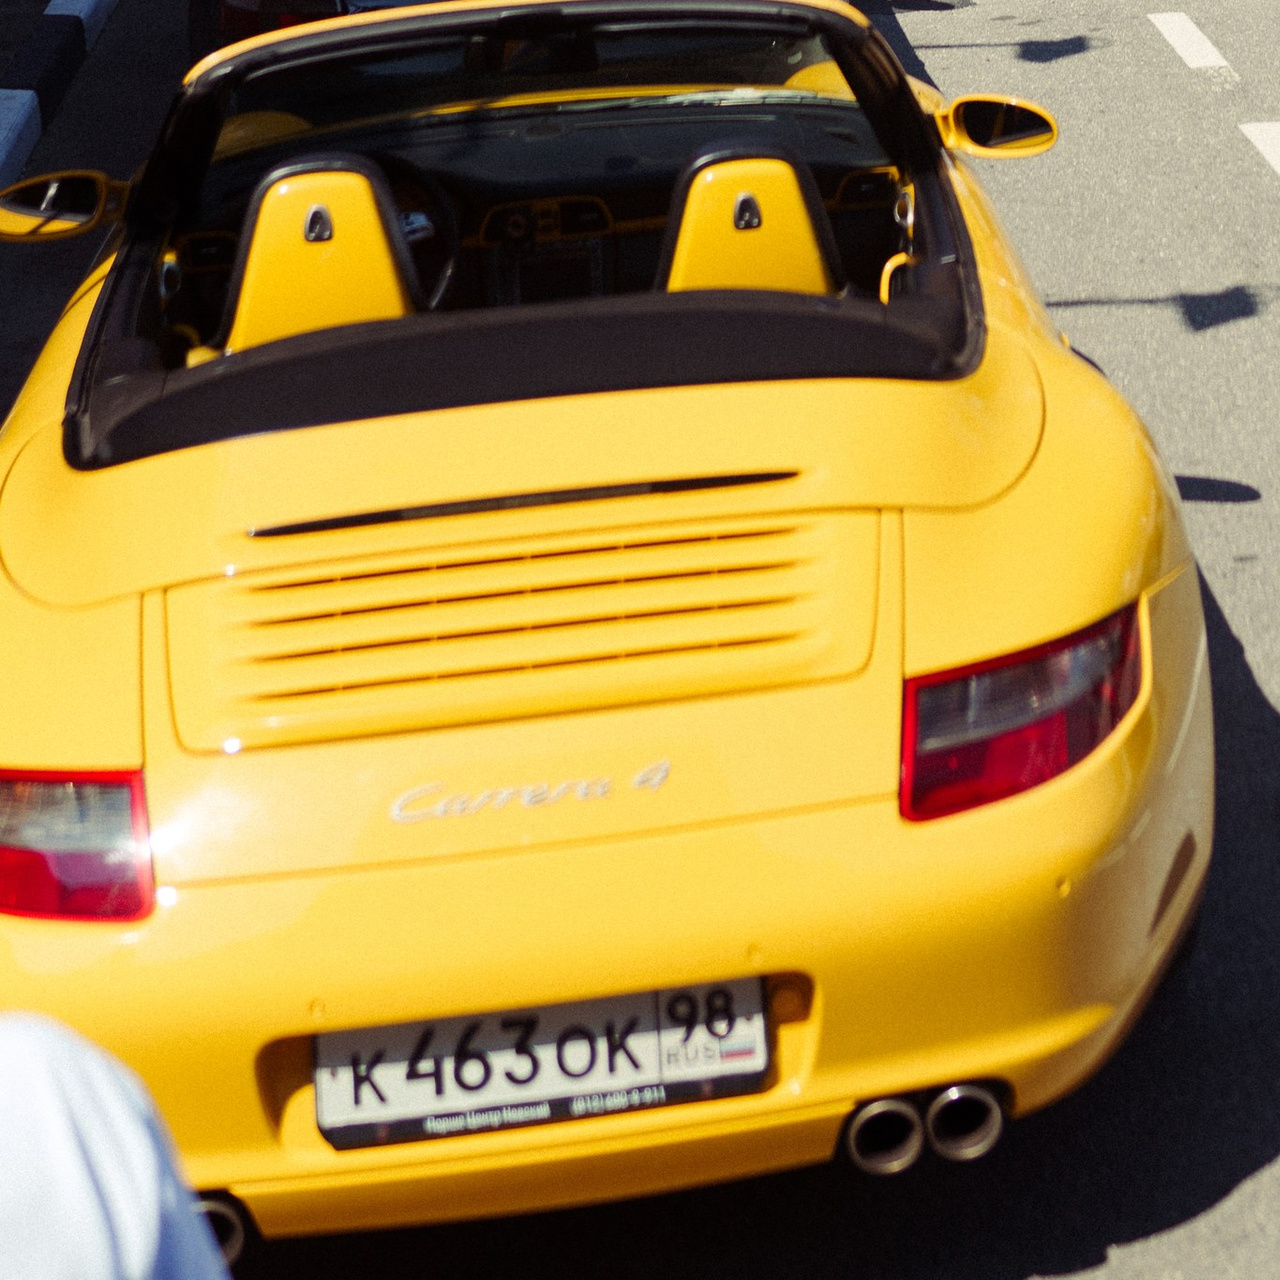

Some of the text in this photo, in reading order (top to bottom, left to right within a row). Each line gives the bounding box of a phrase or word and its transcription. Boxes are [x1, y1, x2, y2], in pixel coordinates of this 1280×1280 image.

[390, 758, 671, 825] Carrera 4
[665, 987, 738, 1044] 98
[666, 1043, 719, 1067] RUS
